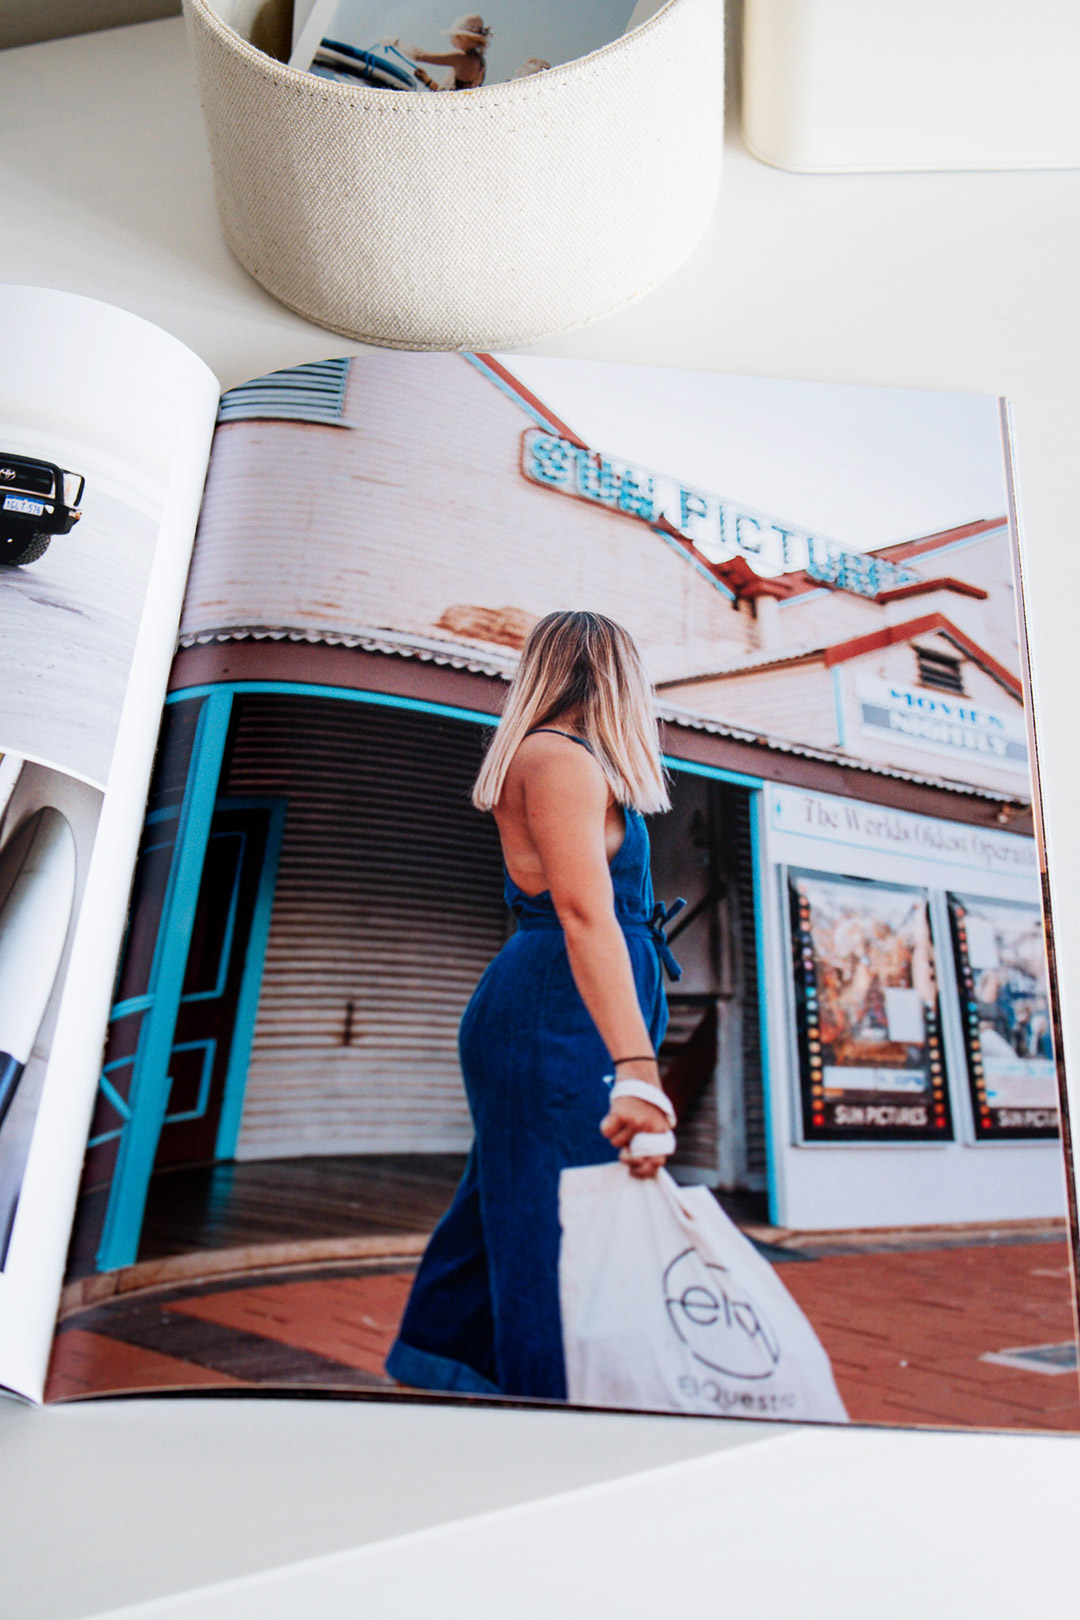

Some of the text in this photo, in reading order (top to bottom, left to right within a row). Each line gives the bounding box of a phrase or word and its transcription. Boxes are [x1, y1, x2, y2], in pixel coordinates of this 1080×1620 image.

[531, 437, 657, 523] SUN
[803, 797, 839, 829] The
[834, 1104, 864, 1125] SUN
